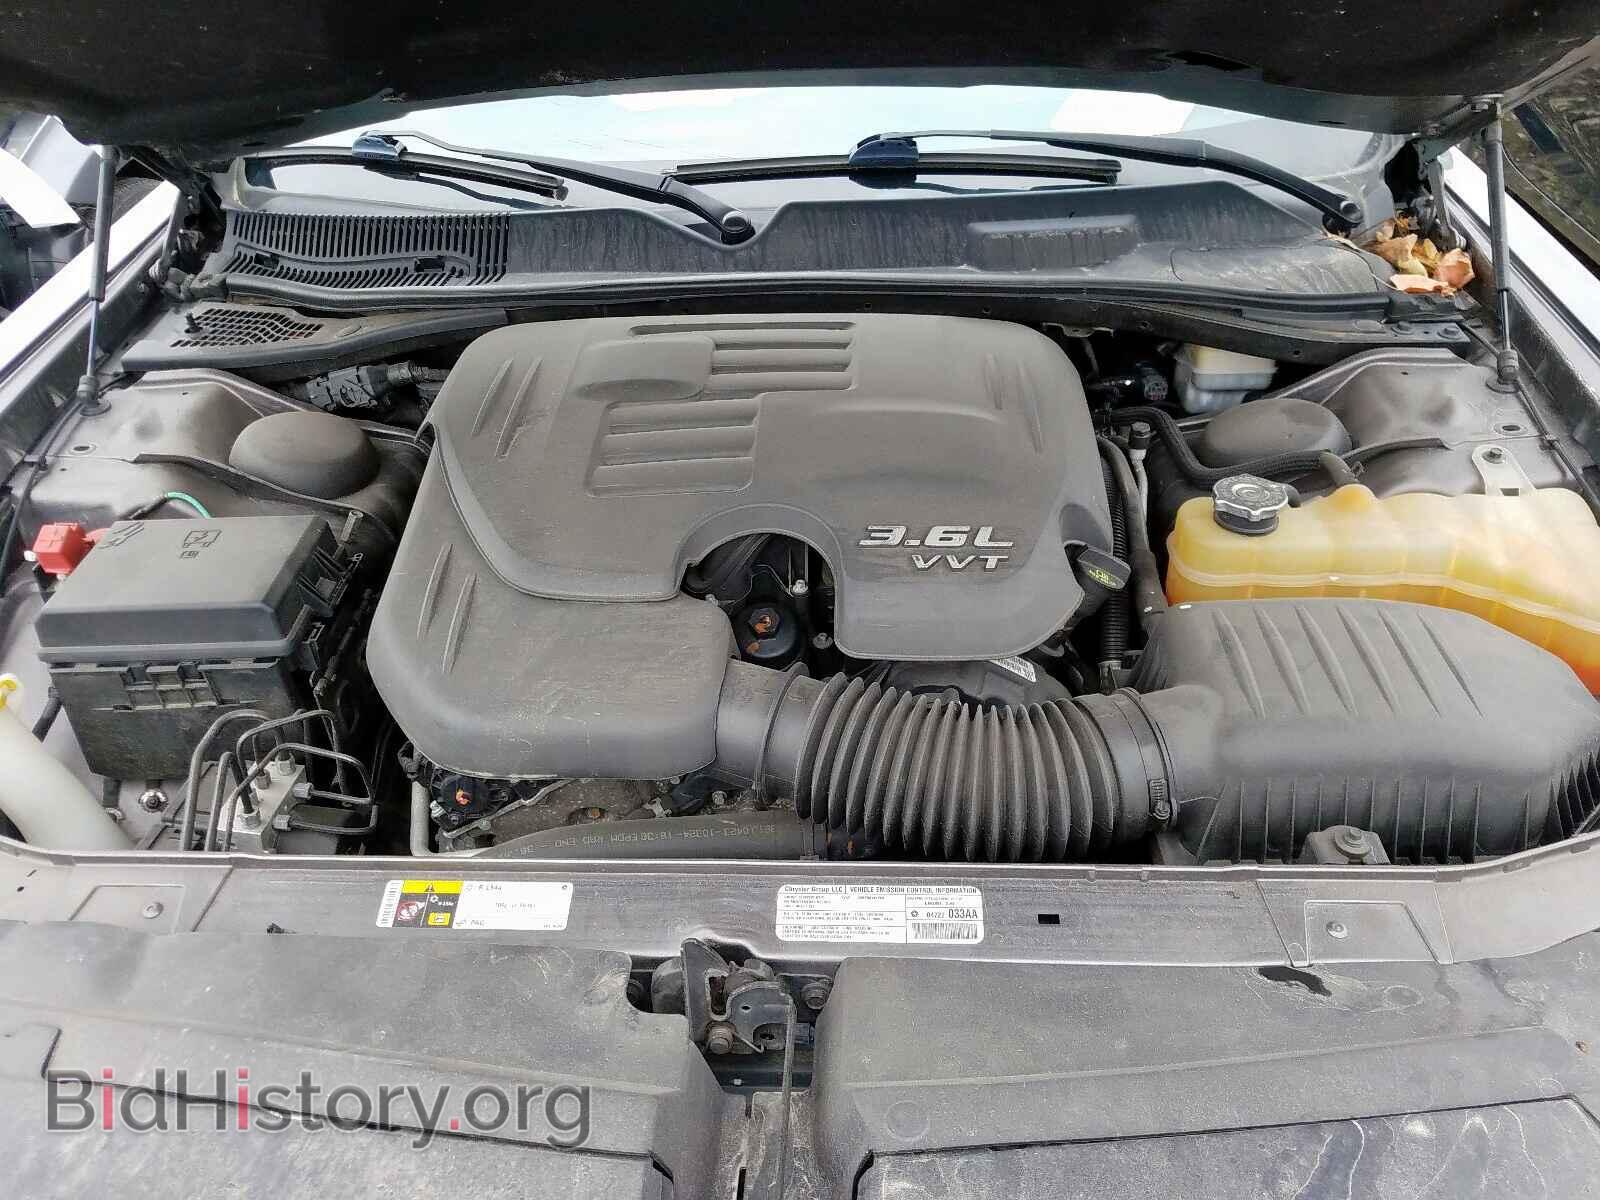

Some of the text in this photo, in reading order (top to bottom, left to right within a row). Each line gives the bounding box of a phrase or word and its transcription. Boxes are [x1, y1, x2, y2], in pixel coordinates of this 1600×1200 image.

[858, 525, 1014, 547] 3.6L
[911, 554, 1009, 571] VVT
[784, 886, 810, 894] Chrysler
[811, 886, 830, 894] Group
[936, 887, 978, 895] INFORMATION
[948, 908, 978, 920] 033AA
